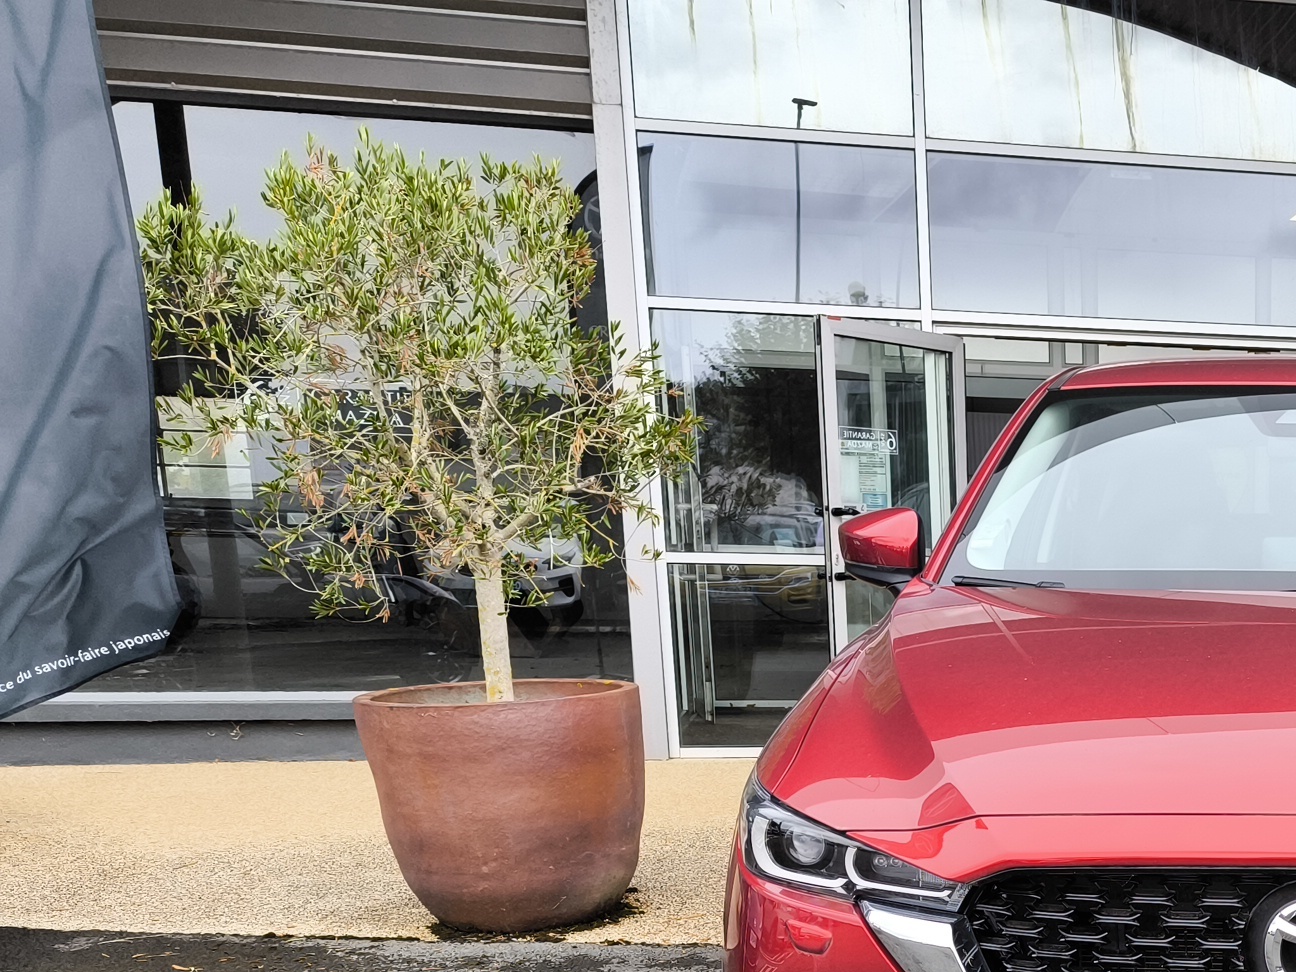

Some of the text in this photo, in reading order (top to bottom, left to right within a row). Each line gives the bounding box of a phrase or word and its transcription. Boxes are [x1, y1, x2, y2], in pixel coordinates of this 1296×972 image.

[311, 389, 412, 405] GRTIE
[332, 409, 403, 426] MAZA
[16, 669, 32, 684] du
[35, 644, 110, 675] savoir-faire
[110, 628, 171, 654] japonais
